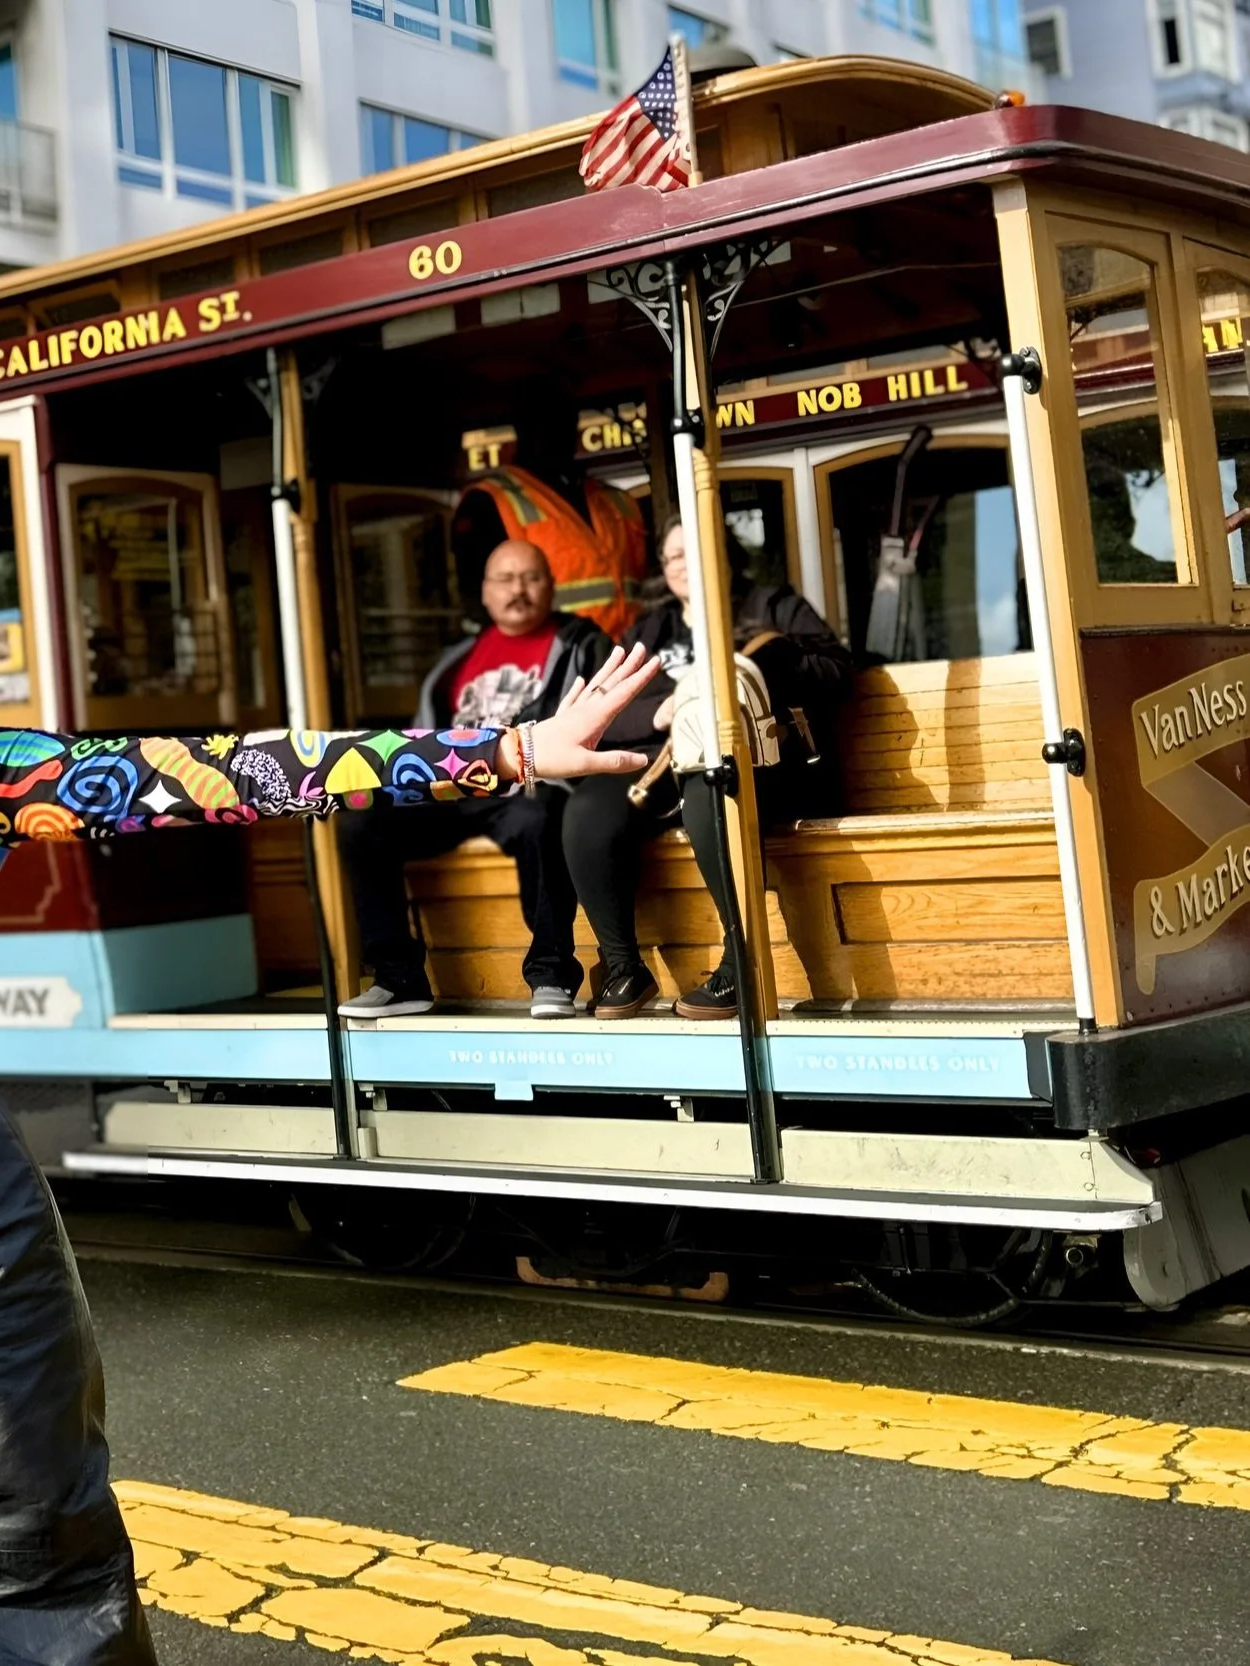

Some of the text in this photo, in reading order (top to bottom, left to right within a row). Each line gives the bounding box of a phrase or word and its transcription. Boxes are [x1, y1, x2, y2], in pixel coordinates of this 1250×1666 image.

[408, 240, 462, 280] 60
[198, 291, 252, 332] ST.
[796, 382, 862, 416] NOB
[886, 365, 968, 401] HILL
[1140, 680, 1248, 759] Van Ness
[1150, 886, 1176, 938] &
[449, 1051, 484, 1064] TWO
[571, 1052, 613, 1066] ONLY
[796, 1055, 838, 1070] TWO
[949, 1056, 1000, 1072] ONLY
